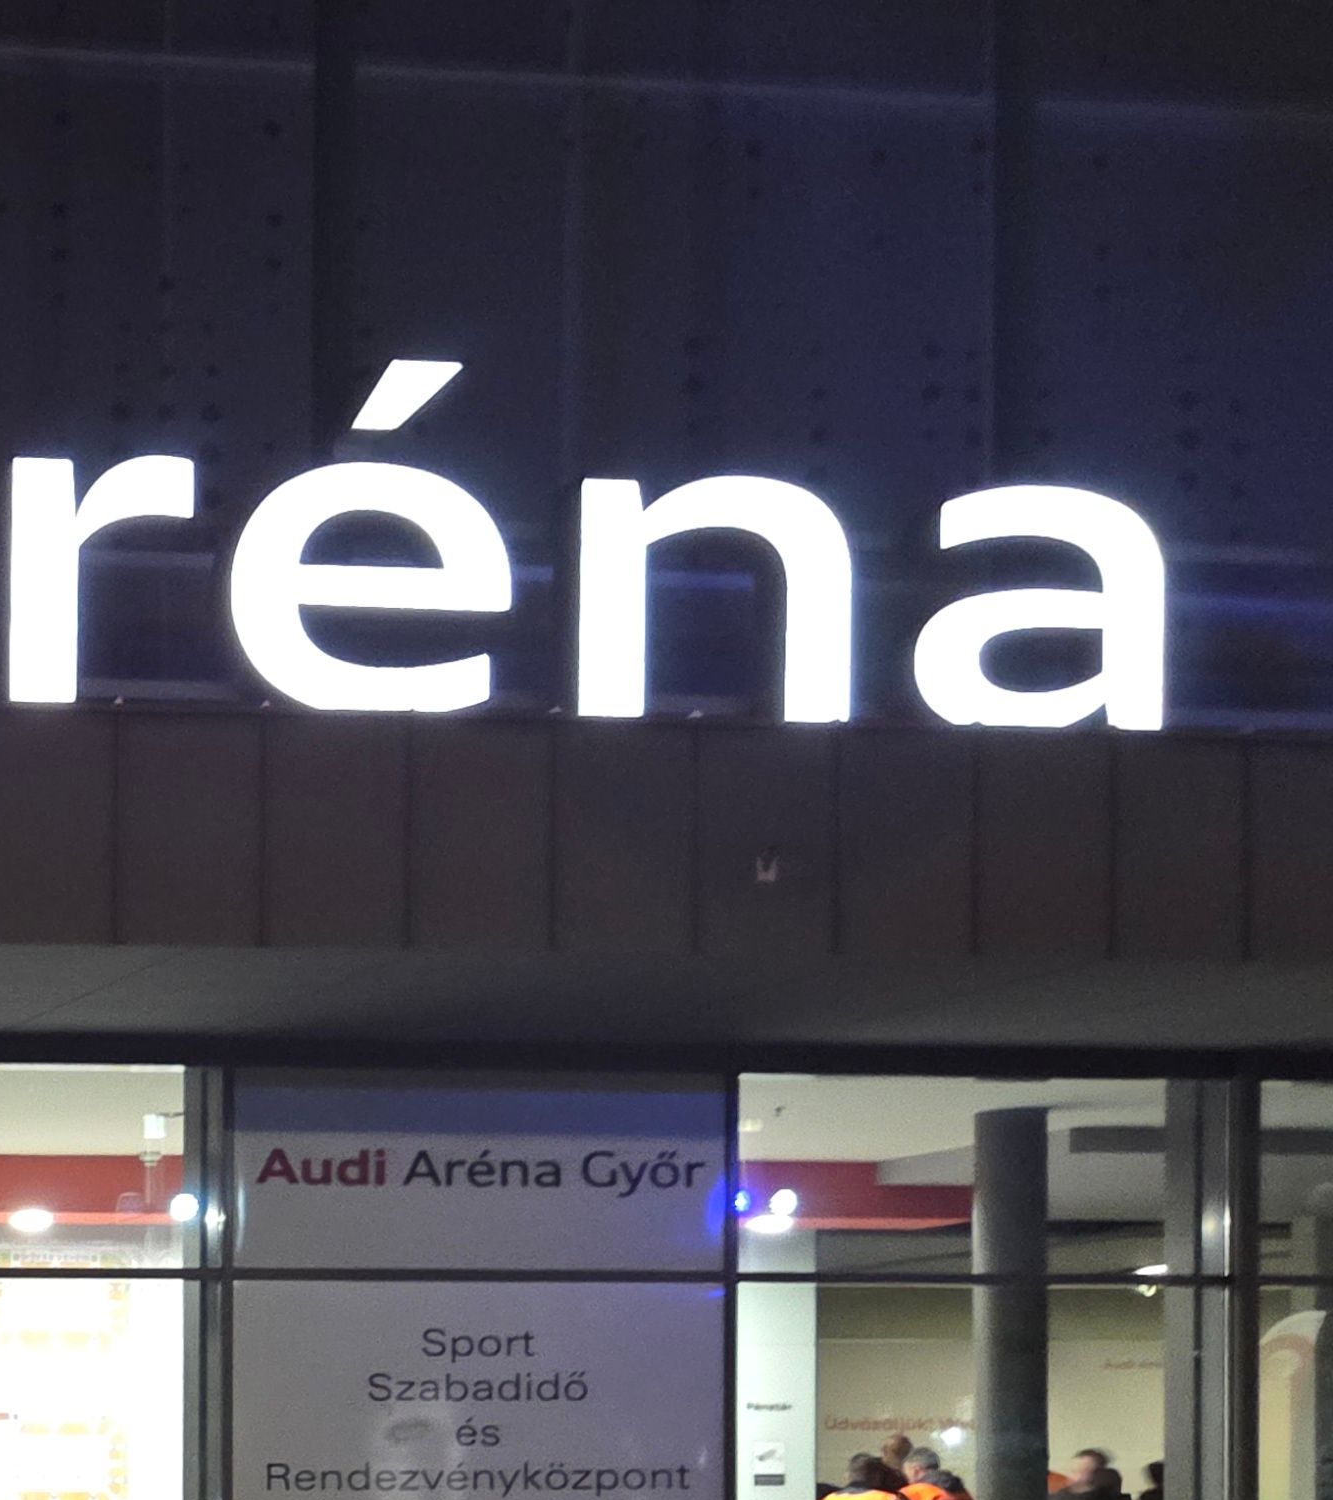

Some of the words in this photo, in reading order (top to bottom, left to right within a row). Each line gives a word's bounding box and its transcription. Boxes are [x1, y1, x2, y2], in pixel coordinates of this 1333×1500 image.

[255, 1147, 387, 1187] Audi
[402, 1147, 563, 1188] Aréna
[580, 1149, 707, 1199] Győr
[421, 1327, 536, 1363] Sport
[367, 1371, 590, 1402] Szabadidő
[455, 1416, 501, 1448] és
[265, 1461, 692, 1498] Rendezvényközpont
